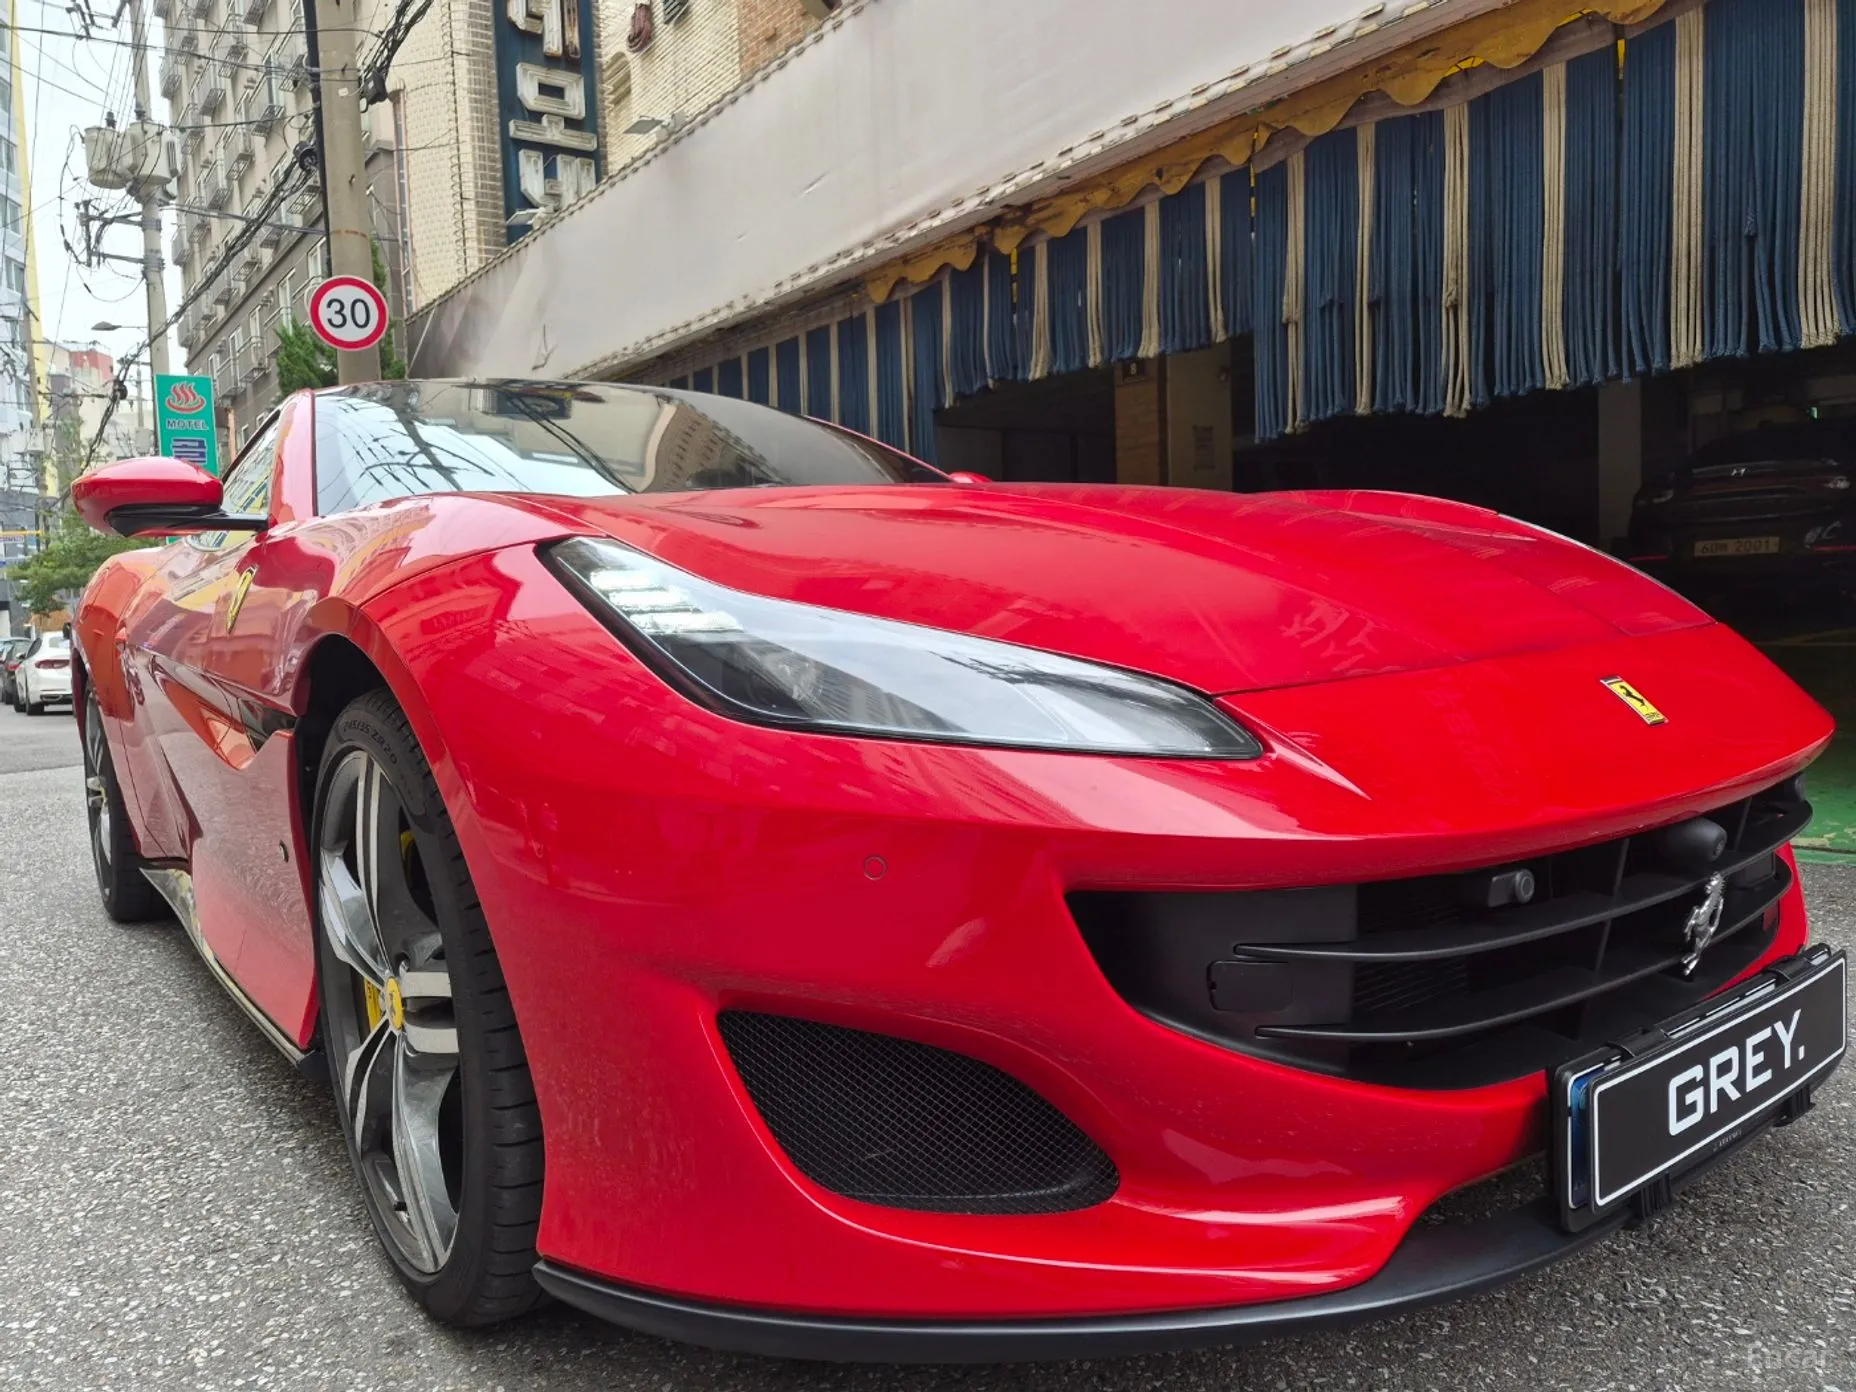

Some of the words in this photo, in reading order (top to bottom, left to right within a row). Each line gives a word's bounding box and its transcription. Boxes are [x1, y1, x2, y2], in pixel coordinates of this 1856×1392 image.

[326, 298, 371, 329] 30
[166, 418, 209, 430] MOTEL
[1735, 539, 1770, 553] 2001
[1668, 1008, 1805, 1136] GREY.
